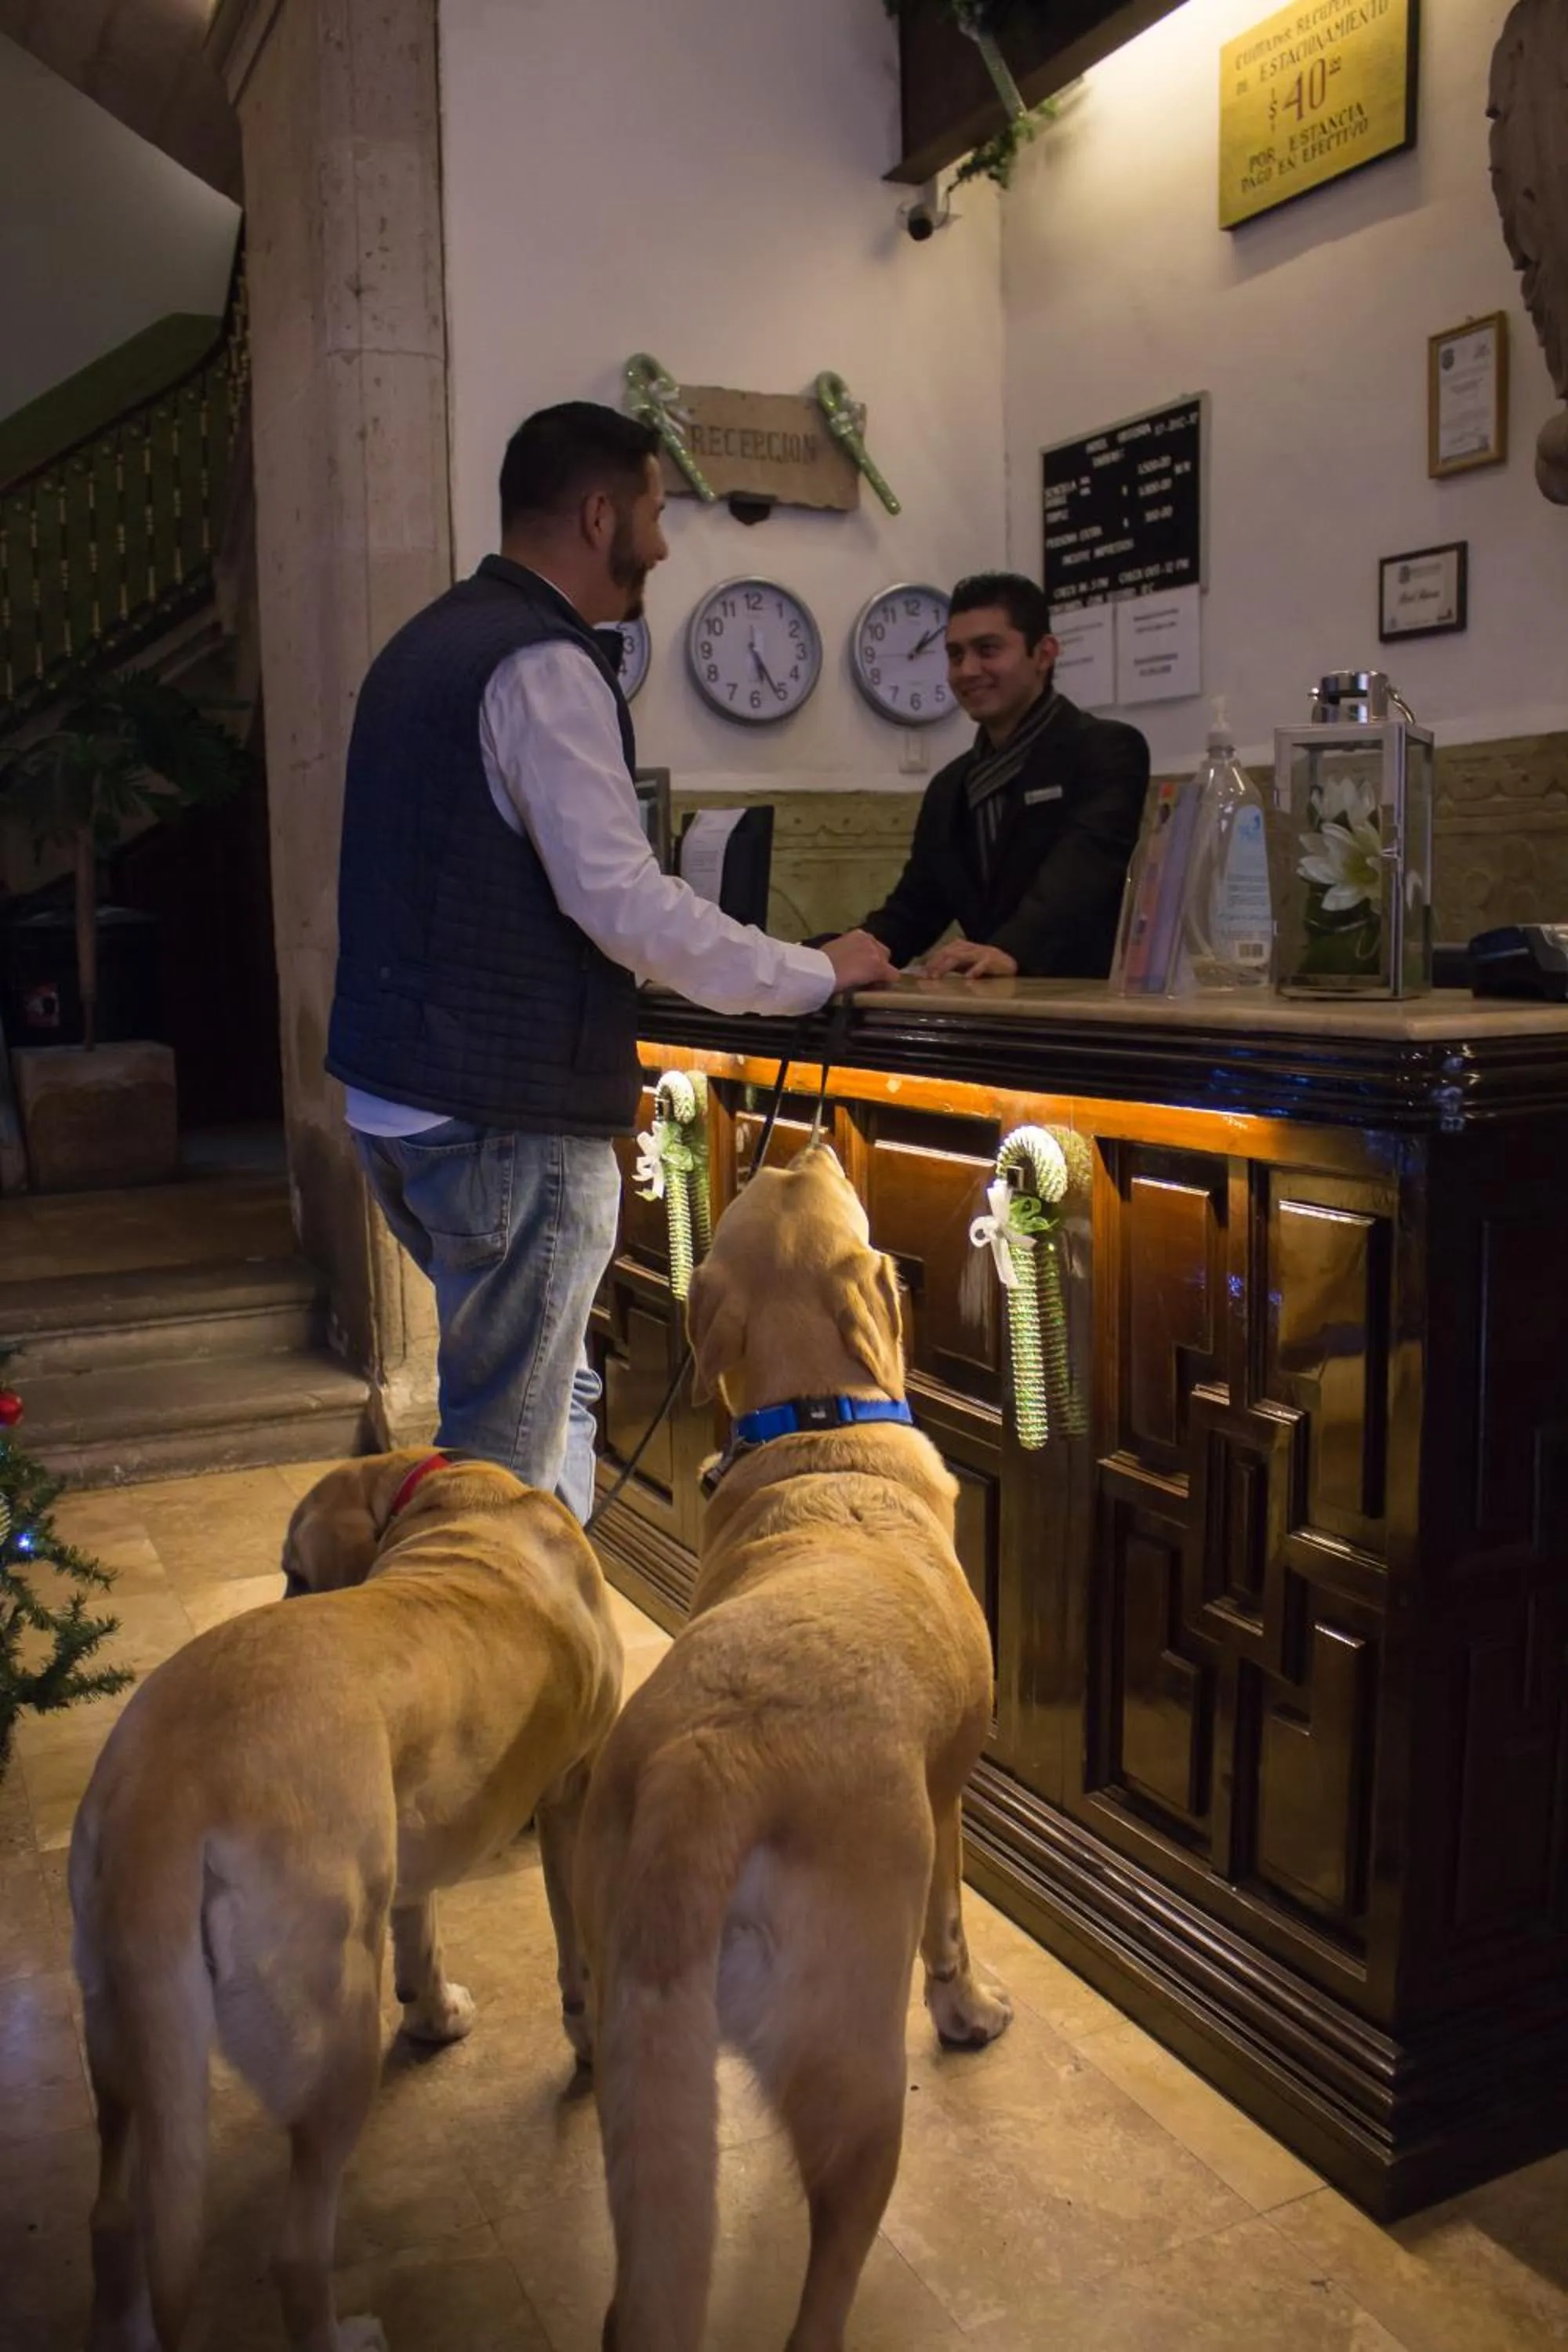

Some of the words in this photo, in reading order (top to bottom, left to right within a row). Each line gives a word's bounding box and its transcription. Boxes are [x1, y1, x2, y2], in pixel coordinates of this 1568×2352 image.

[1259, 0, 1390, 82] ESTACIONAMIENTO
[1249, 147, 1276, 173] POR
[1288, 102, 1366, 151] ESTANCIA
[1278, 158, 1296, 176] EN
[1303, 118, 1369, 163] EFECTIVO
[721, 600, 736, 618] 11
[744, 593, 764, 612] 12
[775, 601, 783, 619] 1
[903, 599, 920, 617] 12
[881, 606, 896, 624] 11
[932, 608, 940, 623] 1
[705, 617, 724, 636] 10
[789, 619, 799, 638] 2
[868, 622, 885, 641] 10
[700, 641, 713, 659] 9
[797, 642, 806, 660] 3
[865, 646, 876, 664] 9
[707, 663, 718, 682] 8
[789, 664, 800, 681] 4
[870, 667, 881, 685] 8
[726, 683, 738, 701] 7
[750, 689, 761, 708] 6
[776, 682, 788, 701] 5
[888, 684, 899, 702] 7
[935, 684, 946, 702] 5
[910, 692, 921, 711] 6
